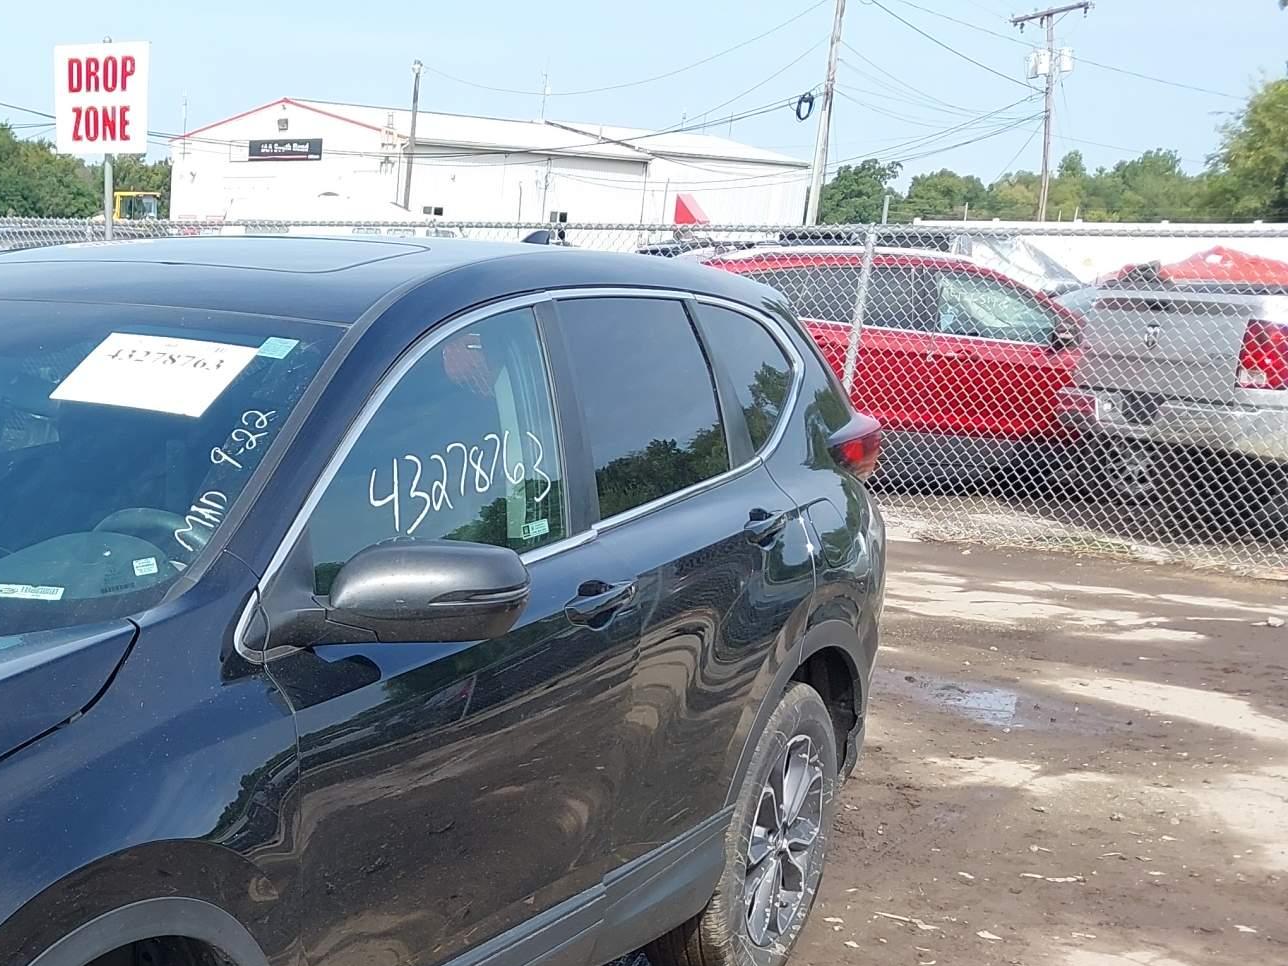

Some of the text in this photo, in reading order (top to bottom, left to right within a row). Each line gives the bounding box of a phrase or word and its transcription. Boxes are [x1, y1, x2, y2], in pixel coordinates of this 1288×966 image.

[67, 55, 136, 93] DROP
[71, 105, 131, 142] ZONE
[105, 349, 225, 371] 43278763
[210, 410, 277, 469] 9-22
[369, 430, 551, 534] 43278763
